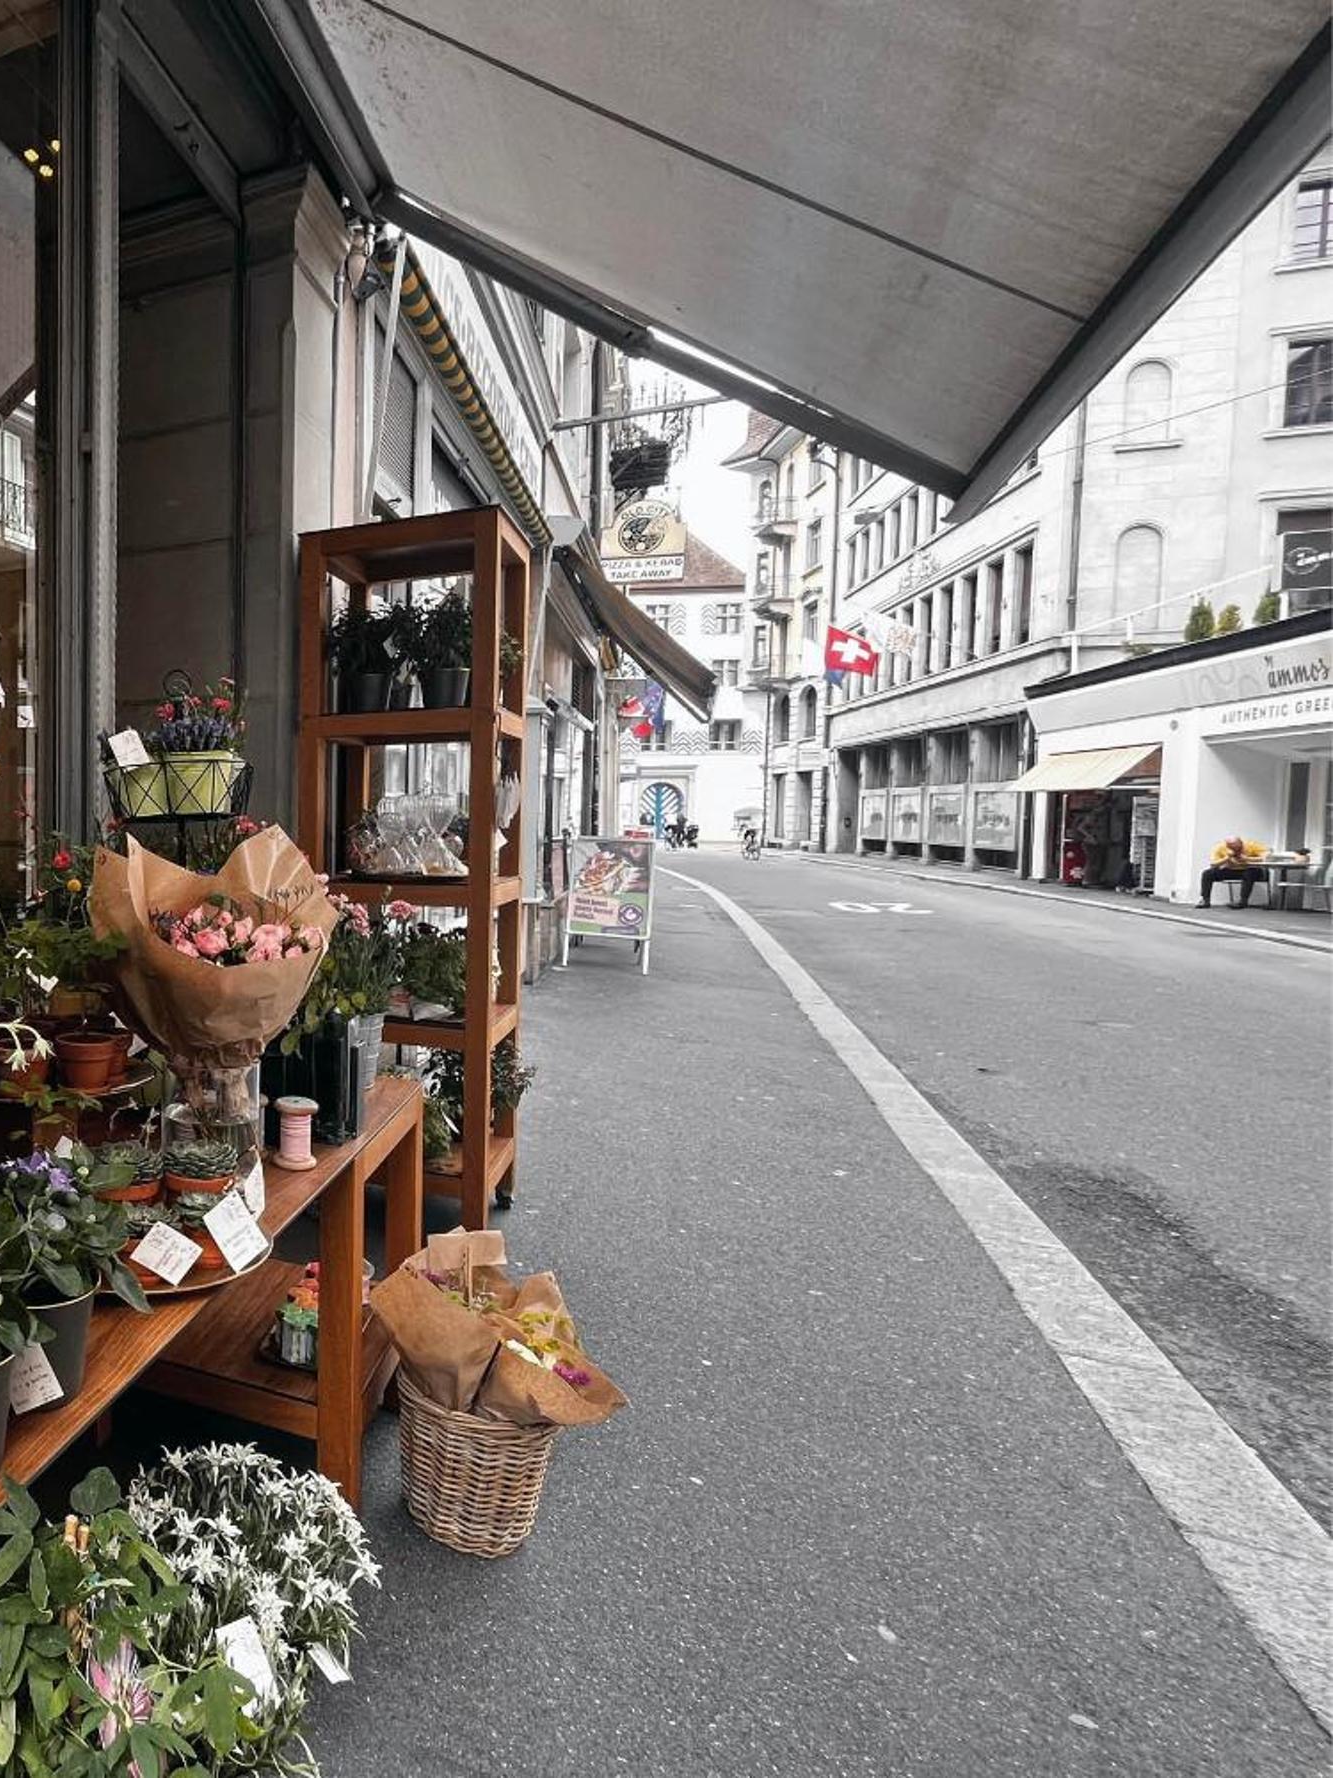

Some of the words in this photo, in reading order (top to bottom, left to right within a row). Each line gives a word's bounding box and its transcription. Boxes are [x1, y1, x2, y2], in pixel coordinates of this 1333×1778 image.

[611, 571, 637, 579] TAKE
[639, 570, 672, 578] AWAY
[1221, 703, 1289, 724] AUTHENTIC
[1295, 697, 1333, 714] GREE
